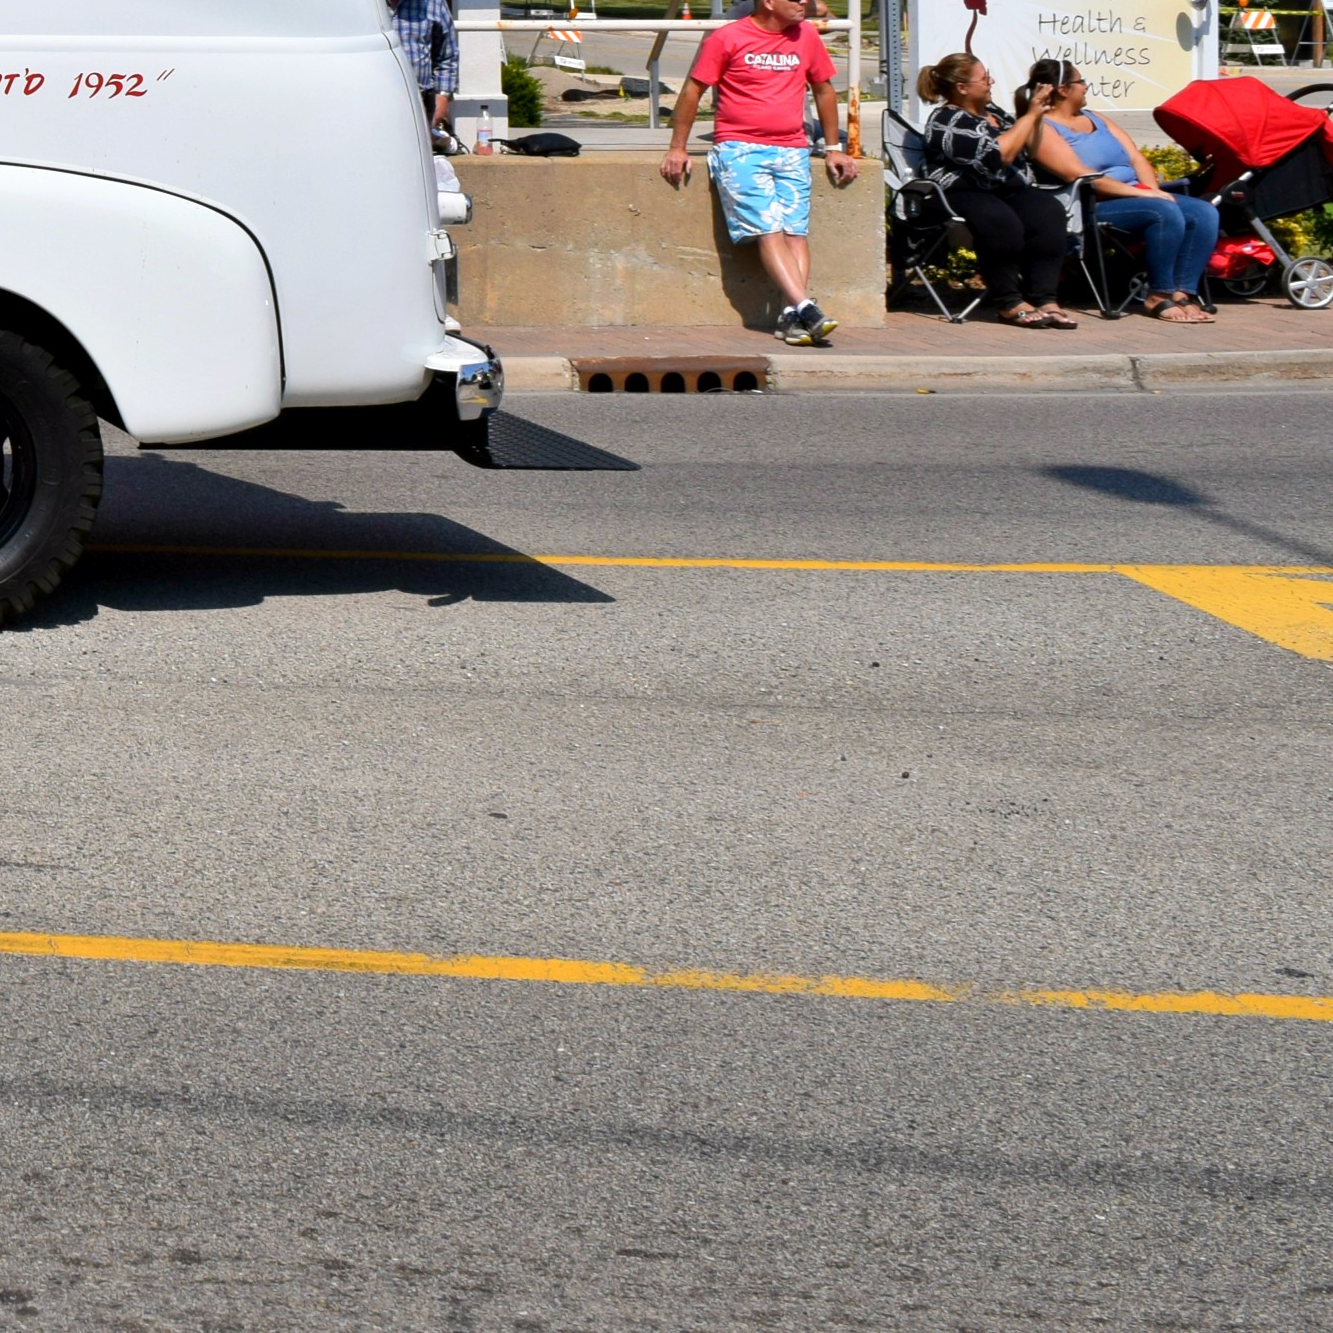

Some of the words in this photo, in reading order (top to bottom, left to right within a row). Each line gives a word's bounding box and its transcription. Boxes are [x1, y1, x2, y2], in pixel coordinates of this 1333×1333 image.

[1037, 8, 1124, 36] Health
[743, 52, 802, 67] CATALINA
[1031, 41, 1151, 67] Wellness
